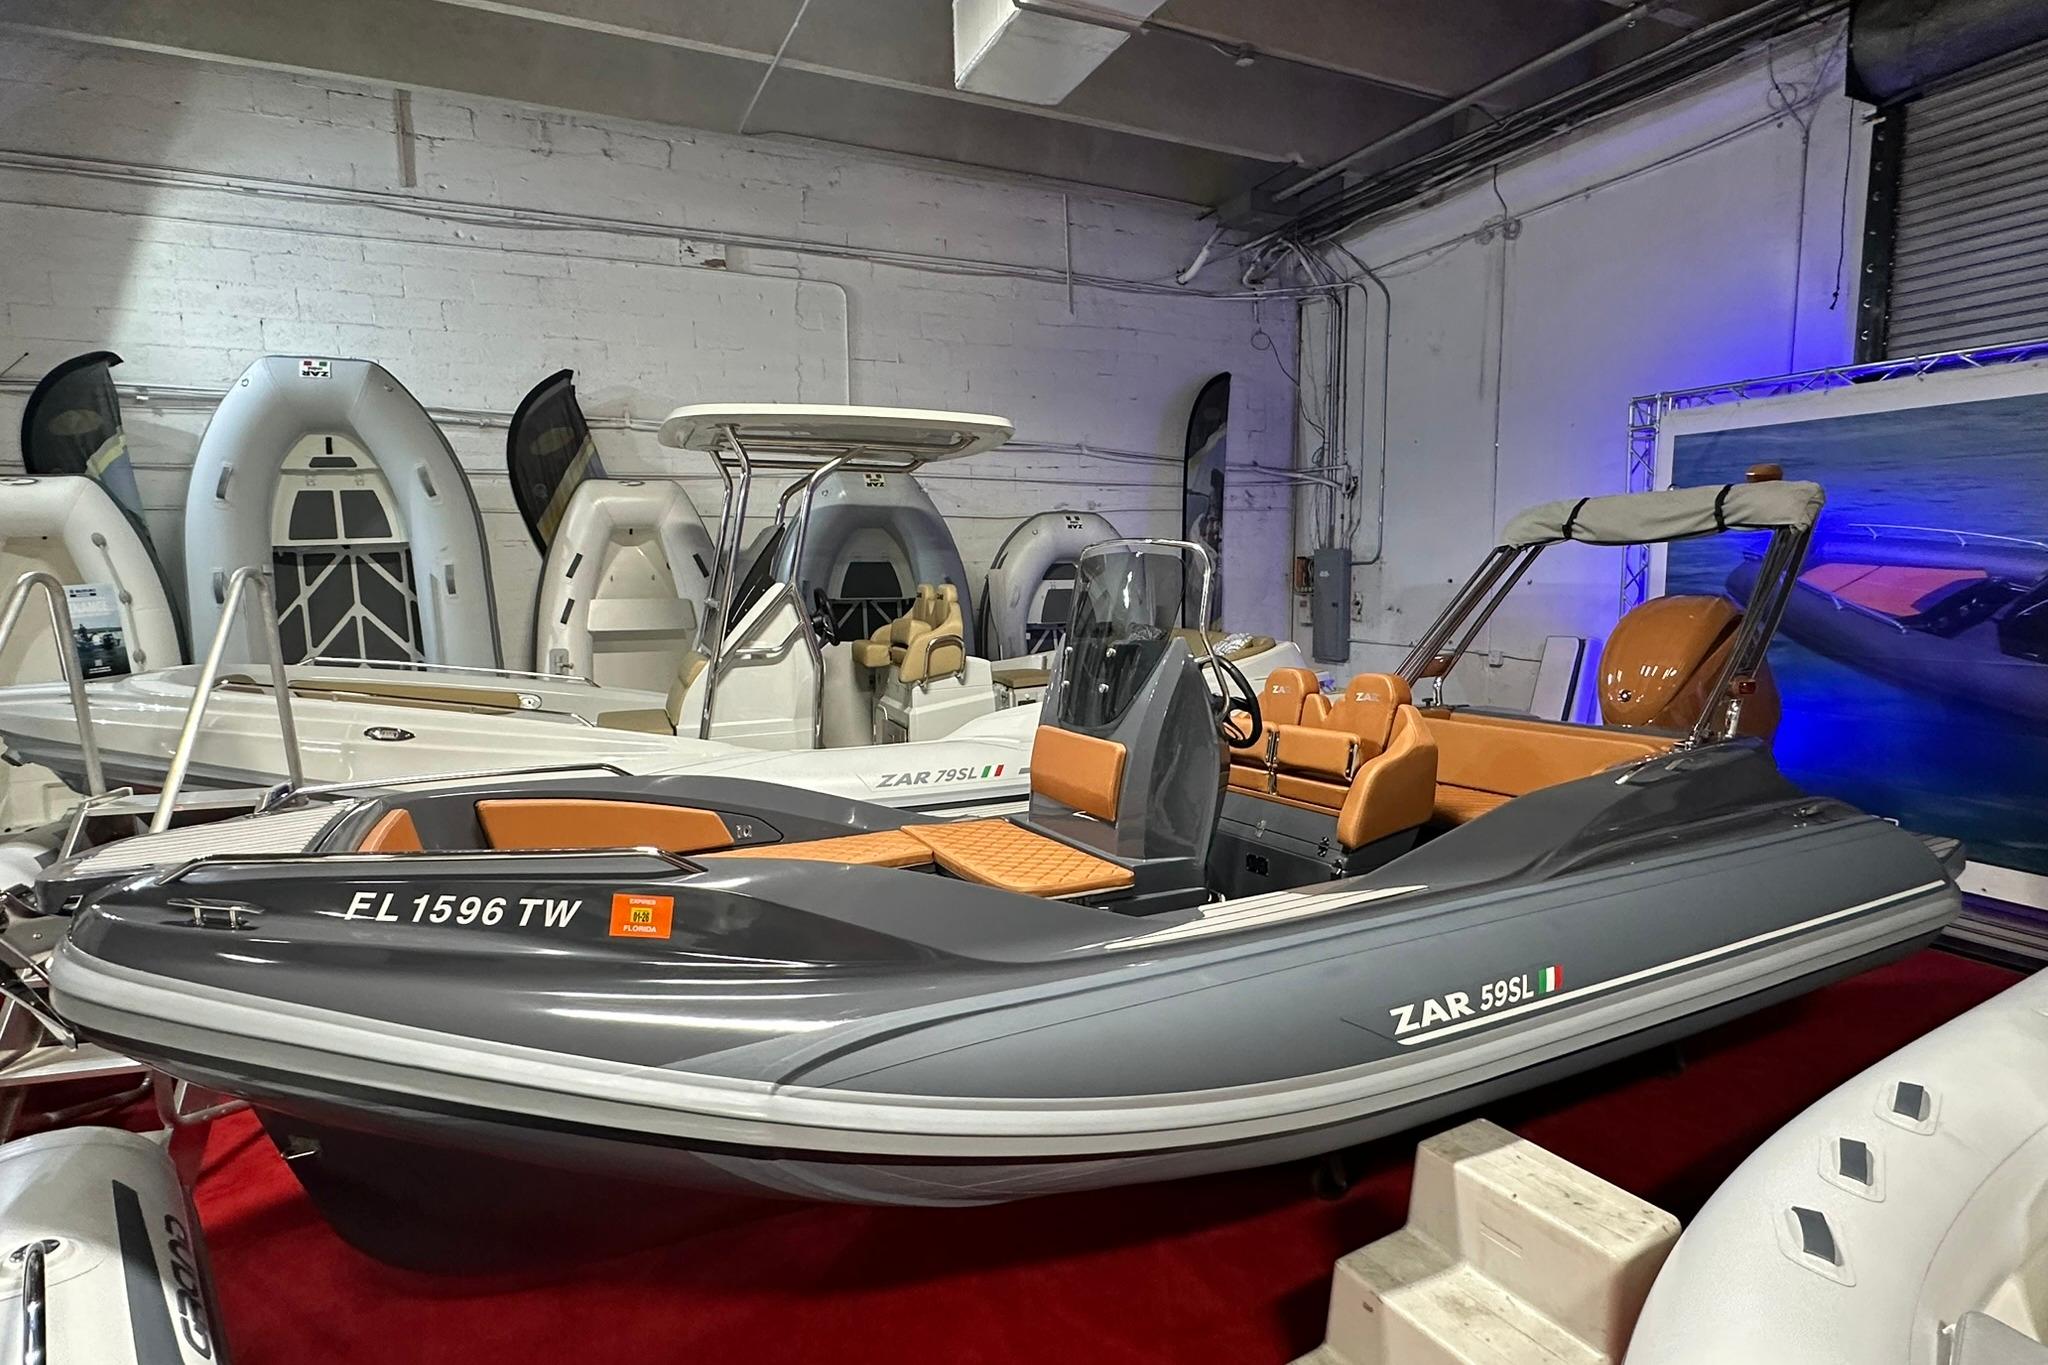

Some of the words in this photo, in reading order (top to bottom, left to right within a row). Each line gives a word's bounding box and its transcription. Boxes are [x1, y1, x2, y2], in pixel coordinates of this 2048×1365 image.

[876, 771, 931, 788] ZAR
[934, 767, 977, 784] 79SL
[411, 894, 507, 926] 1596
[518, 898, 582, 928] TW
[623, 924, 657, 933] FLORIDA
[1389, 991, 1476, 1036] ZAR
[1480, 974, 1534, 1011] 59SL
